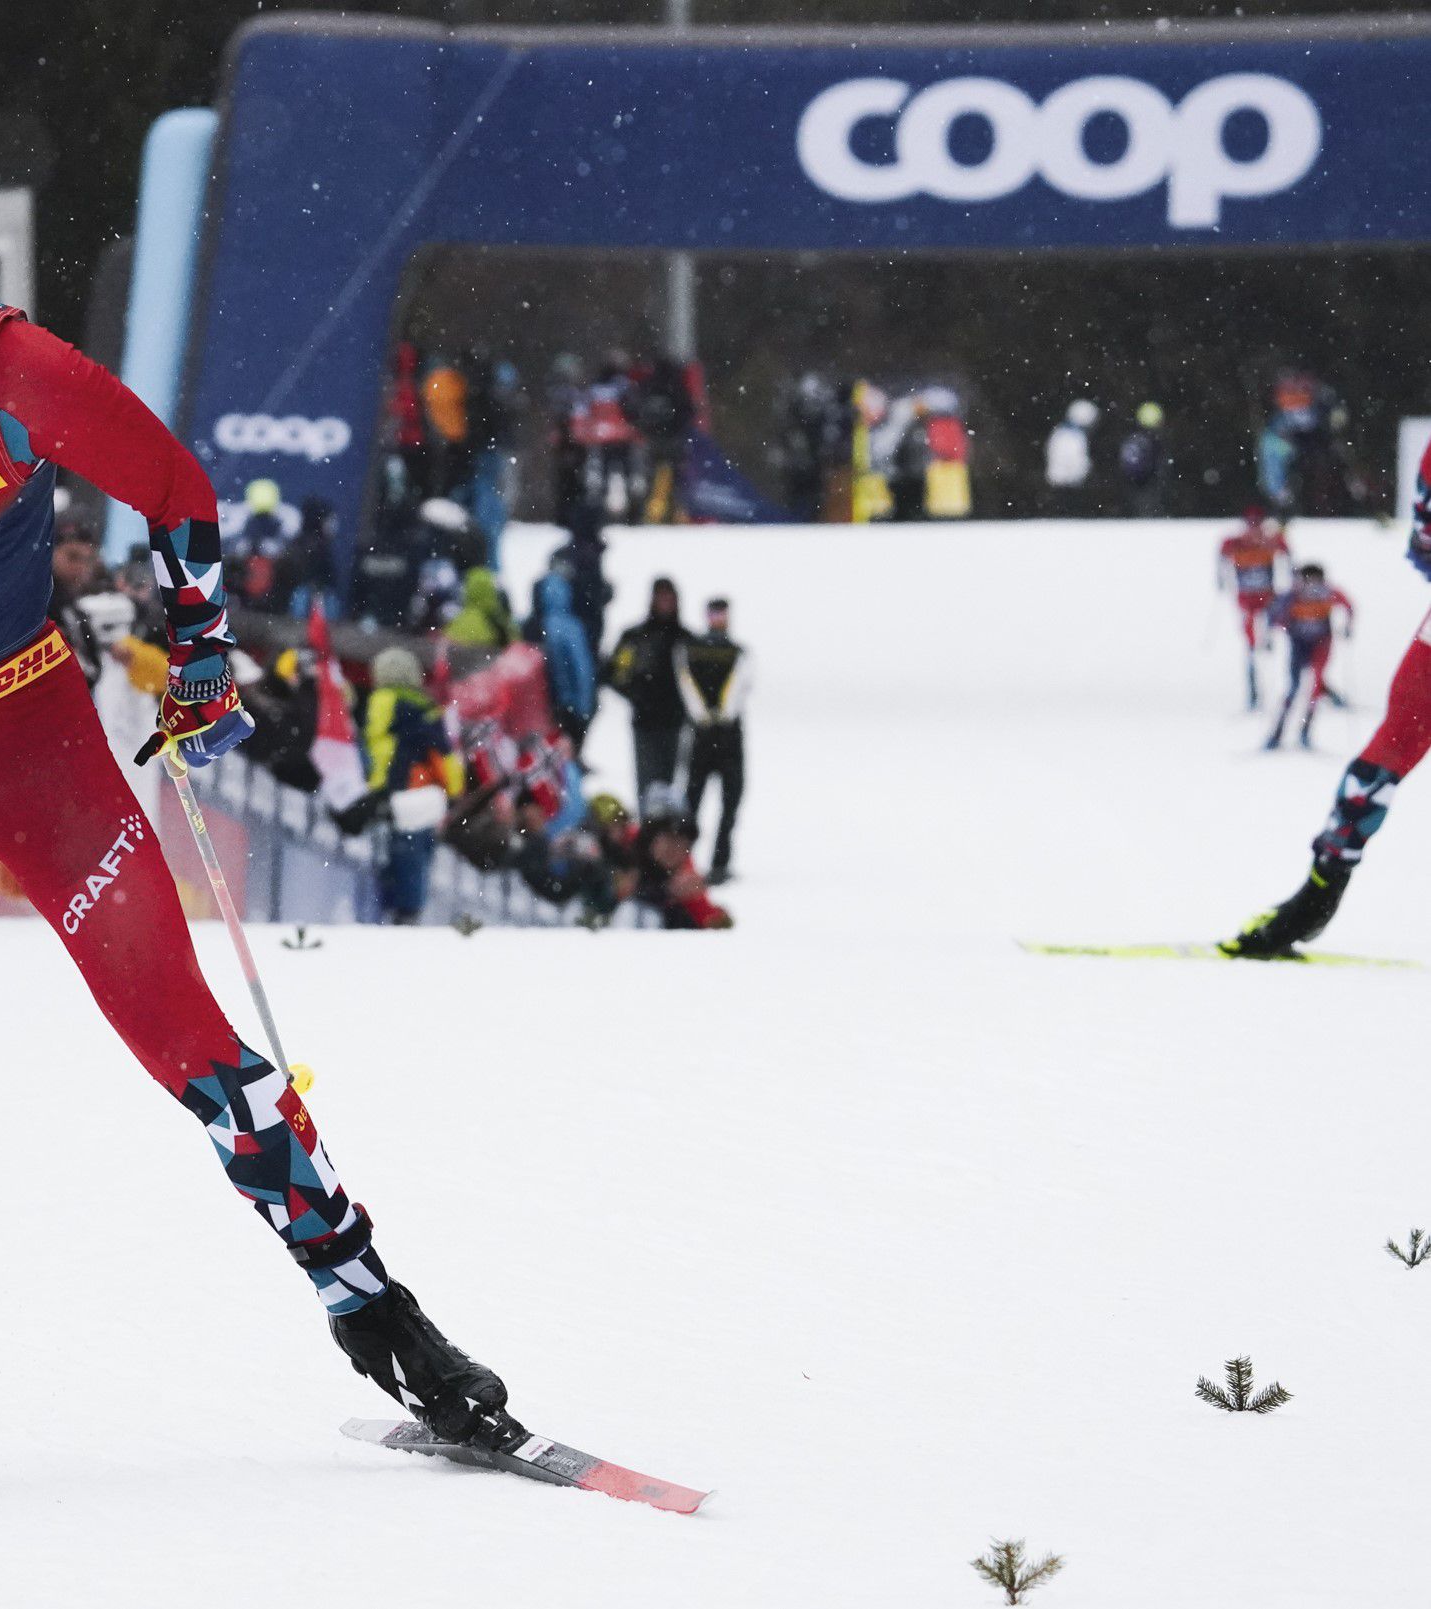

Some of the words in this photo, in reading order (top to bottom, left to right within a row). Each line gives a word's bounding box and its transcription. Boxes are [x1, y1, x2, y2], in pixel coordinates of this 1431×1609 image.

[796, 72, 1322, 228] coop
[214, 413, 351, 462] coop
[63, 830, 135, 935] CRAFT
